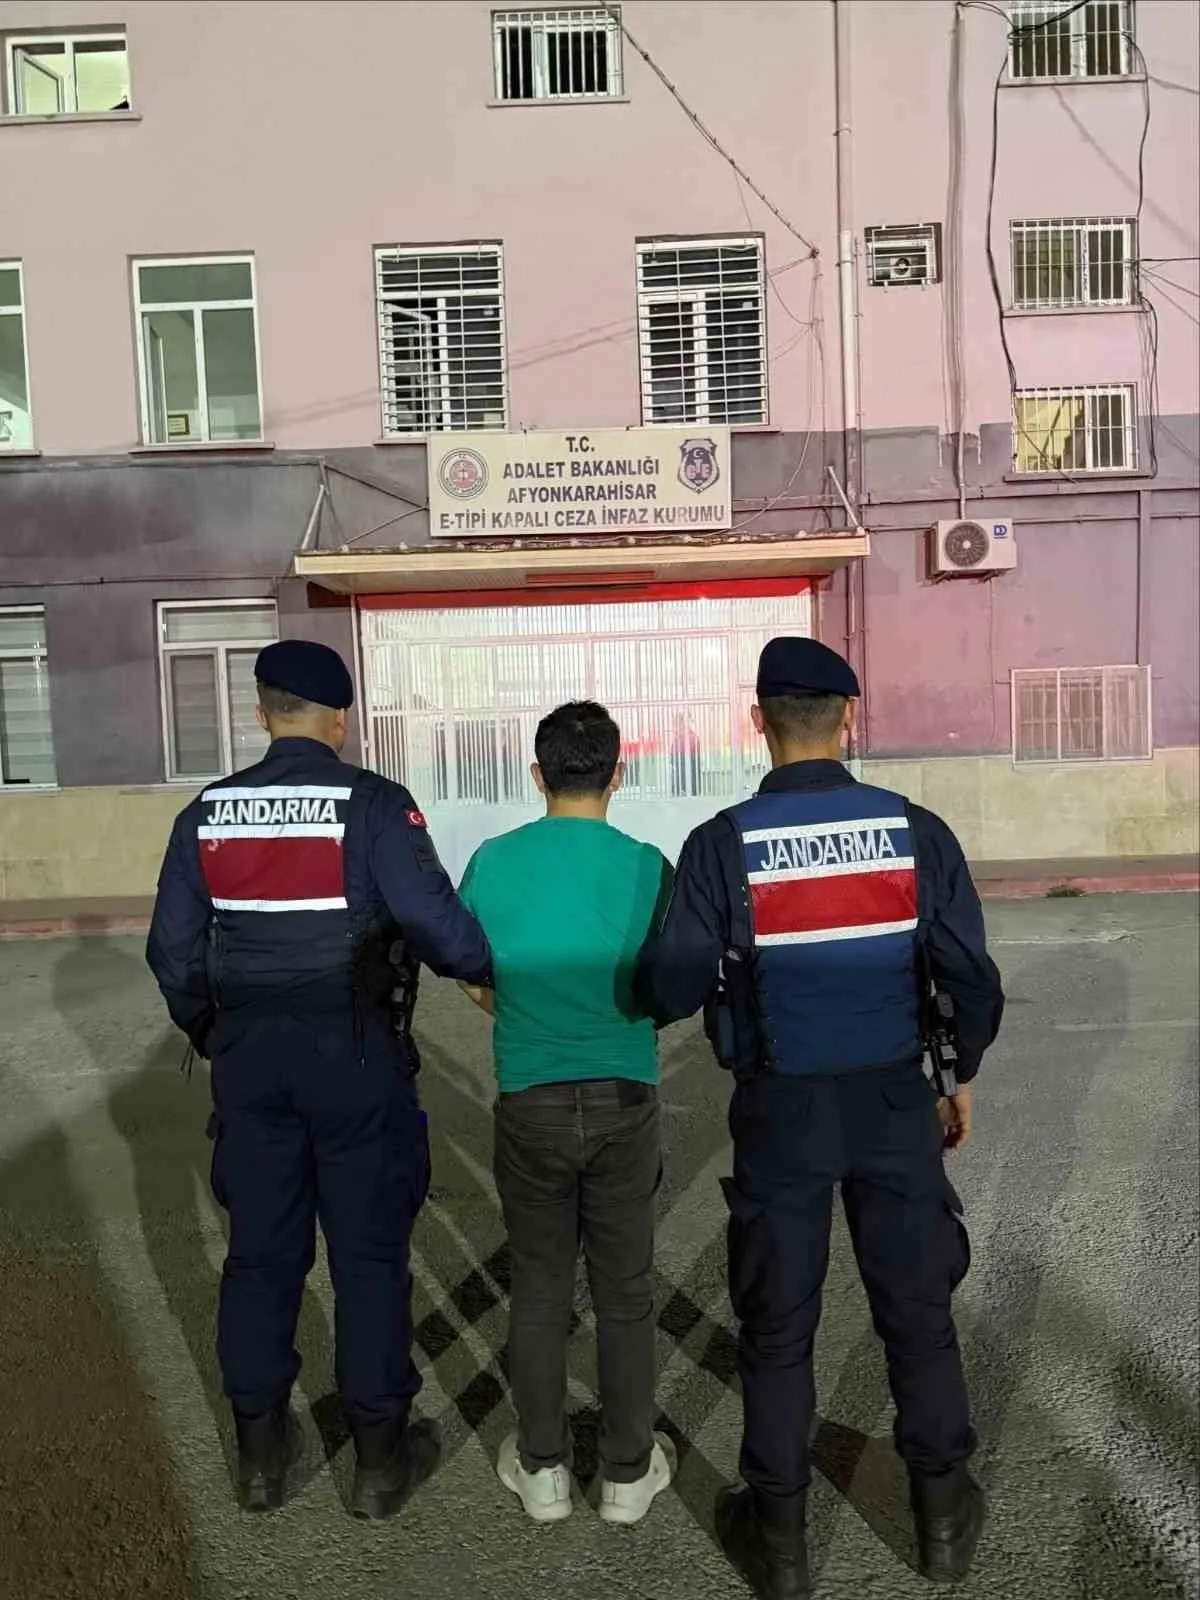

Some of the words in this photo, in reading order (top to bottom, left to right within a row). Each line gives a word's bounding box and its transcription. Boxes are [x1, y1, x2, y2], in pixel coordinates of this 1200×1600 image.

[565, 436, 595, 453] T.C.
[503, 462, 565, 479] ADALET
[571, 456, 660, 477] BAKANLIĞI
[507, 481, 657, 504] AFYONKARAHİSAR
[440, 509, 486, 529] E-TİPİ
[492, 510, 549, 528] KAPALI
[555, 509, 597, 527] CEZA
[601, 505, 649, 525] İNFAZ
[653, 505, 725, 523] KURUMU
[207, 799, 338, 825] JANDARMA
[760, 829, 897, 870] JANDARMA
